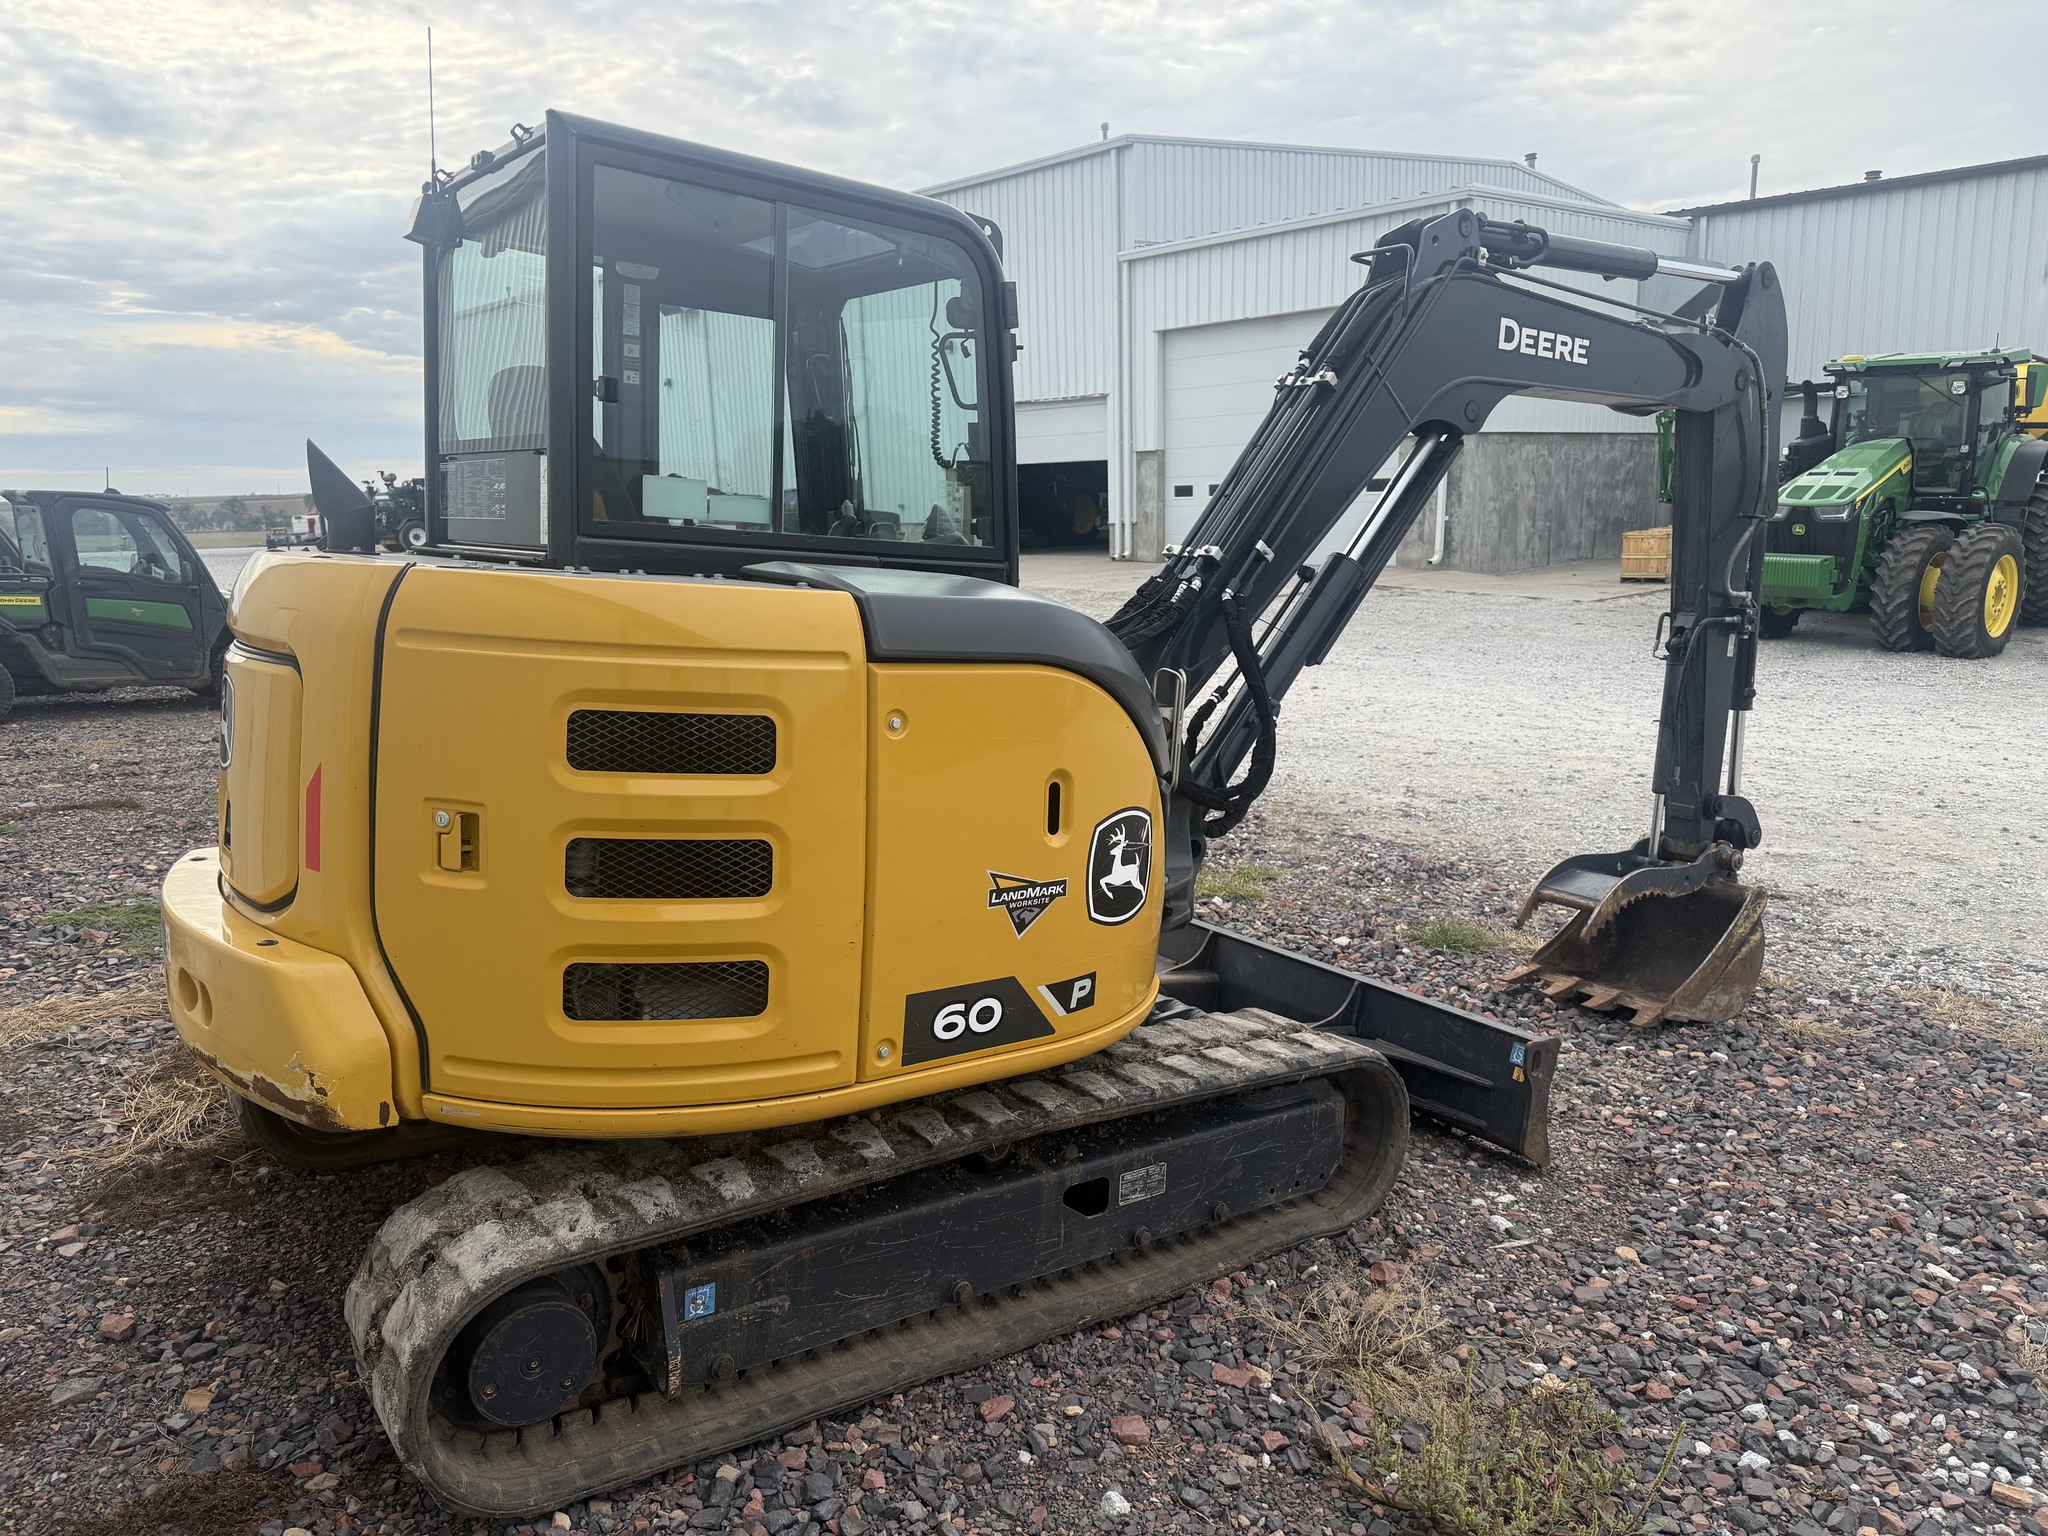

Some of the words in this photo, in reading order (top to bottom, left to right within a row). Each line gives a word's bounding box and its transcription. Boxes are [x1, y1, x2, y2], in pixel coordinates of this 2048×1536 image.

[1498, 317, 1590, 365] DEERE
[991, 884, 1065, 904] LANDMARK
[1009, 897, 1051, 909] WORKSITE
[933, 997, 1003, 1040] 60
[1069, 978, 1092, 1010] P
